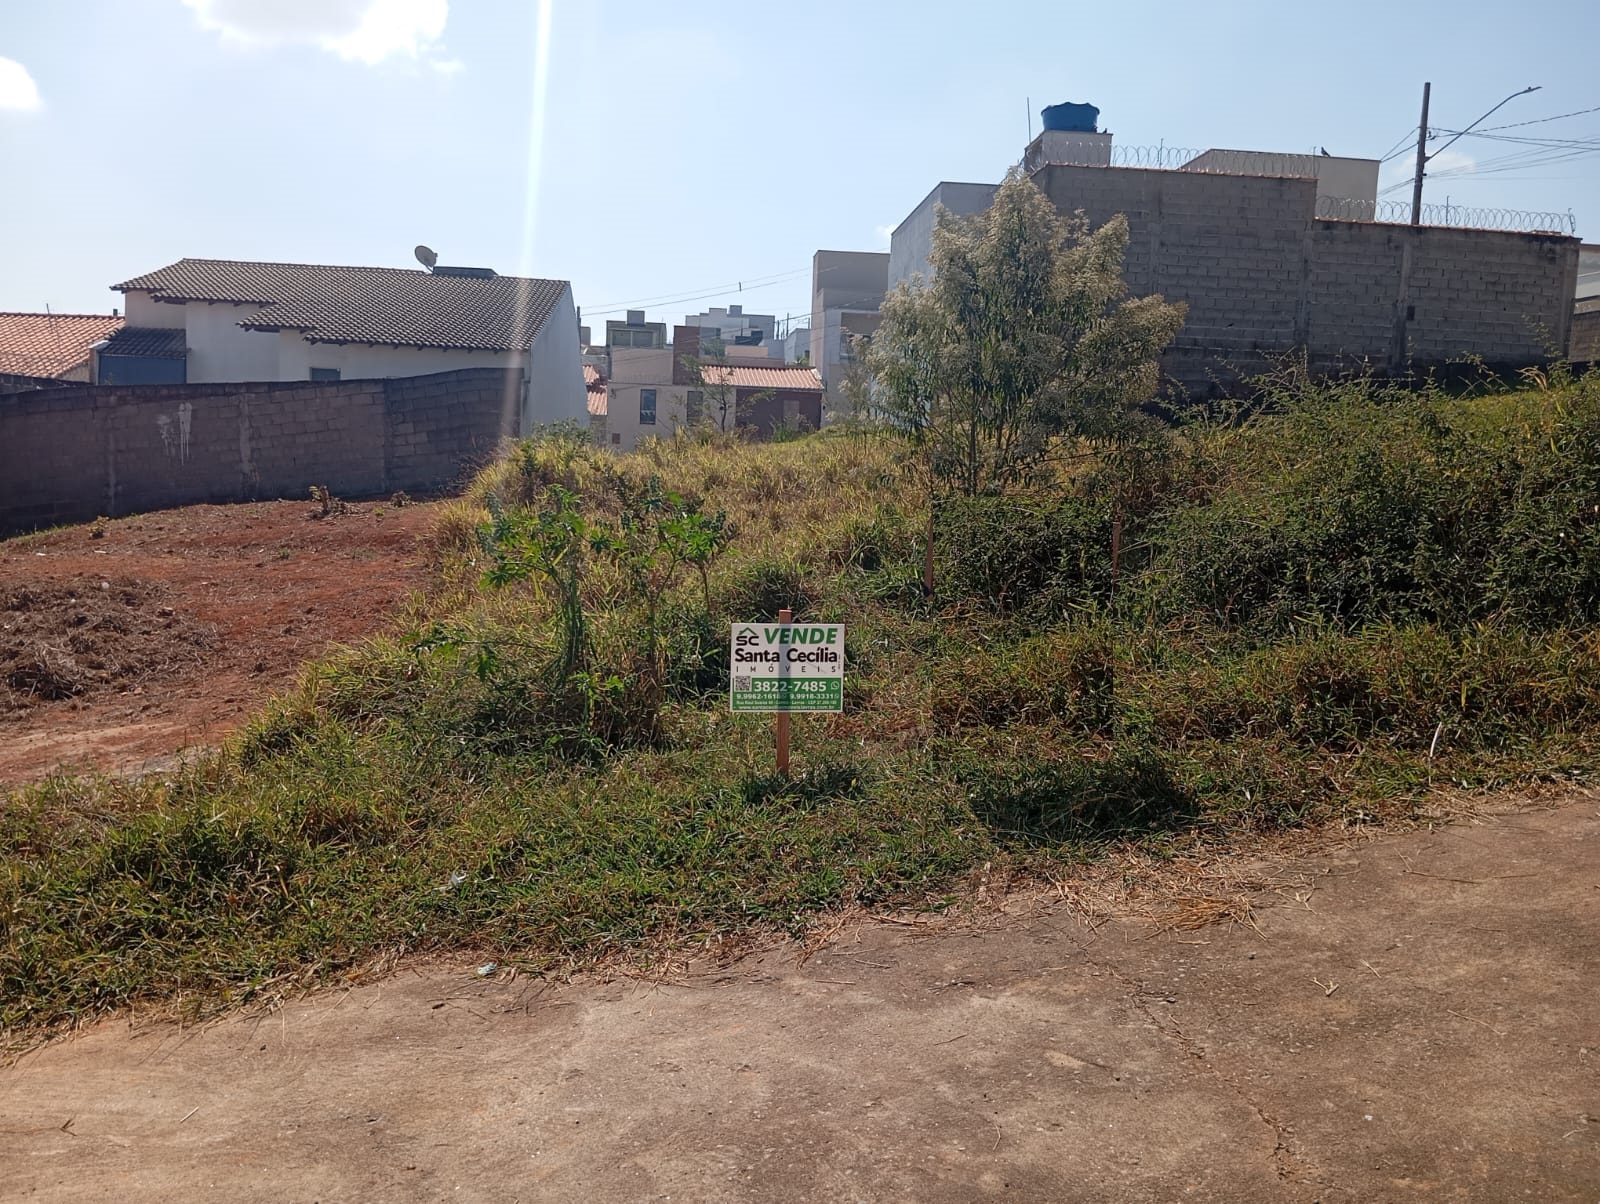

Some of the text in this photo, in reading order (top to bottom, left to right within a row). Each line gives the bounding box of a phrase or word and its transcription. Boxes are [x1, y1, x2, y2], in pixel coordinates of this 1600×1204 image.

[736, 635, 760, 646] SC
[764, 628, 838, 645] VENDE
[735, 648, 780, 663] Santa
[786, 647, 838, 663] Cecília
[754, 681, 827, 692] 3822-7485
